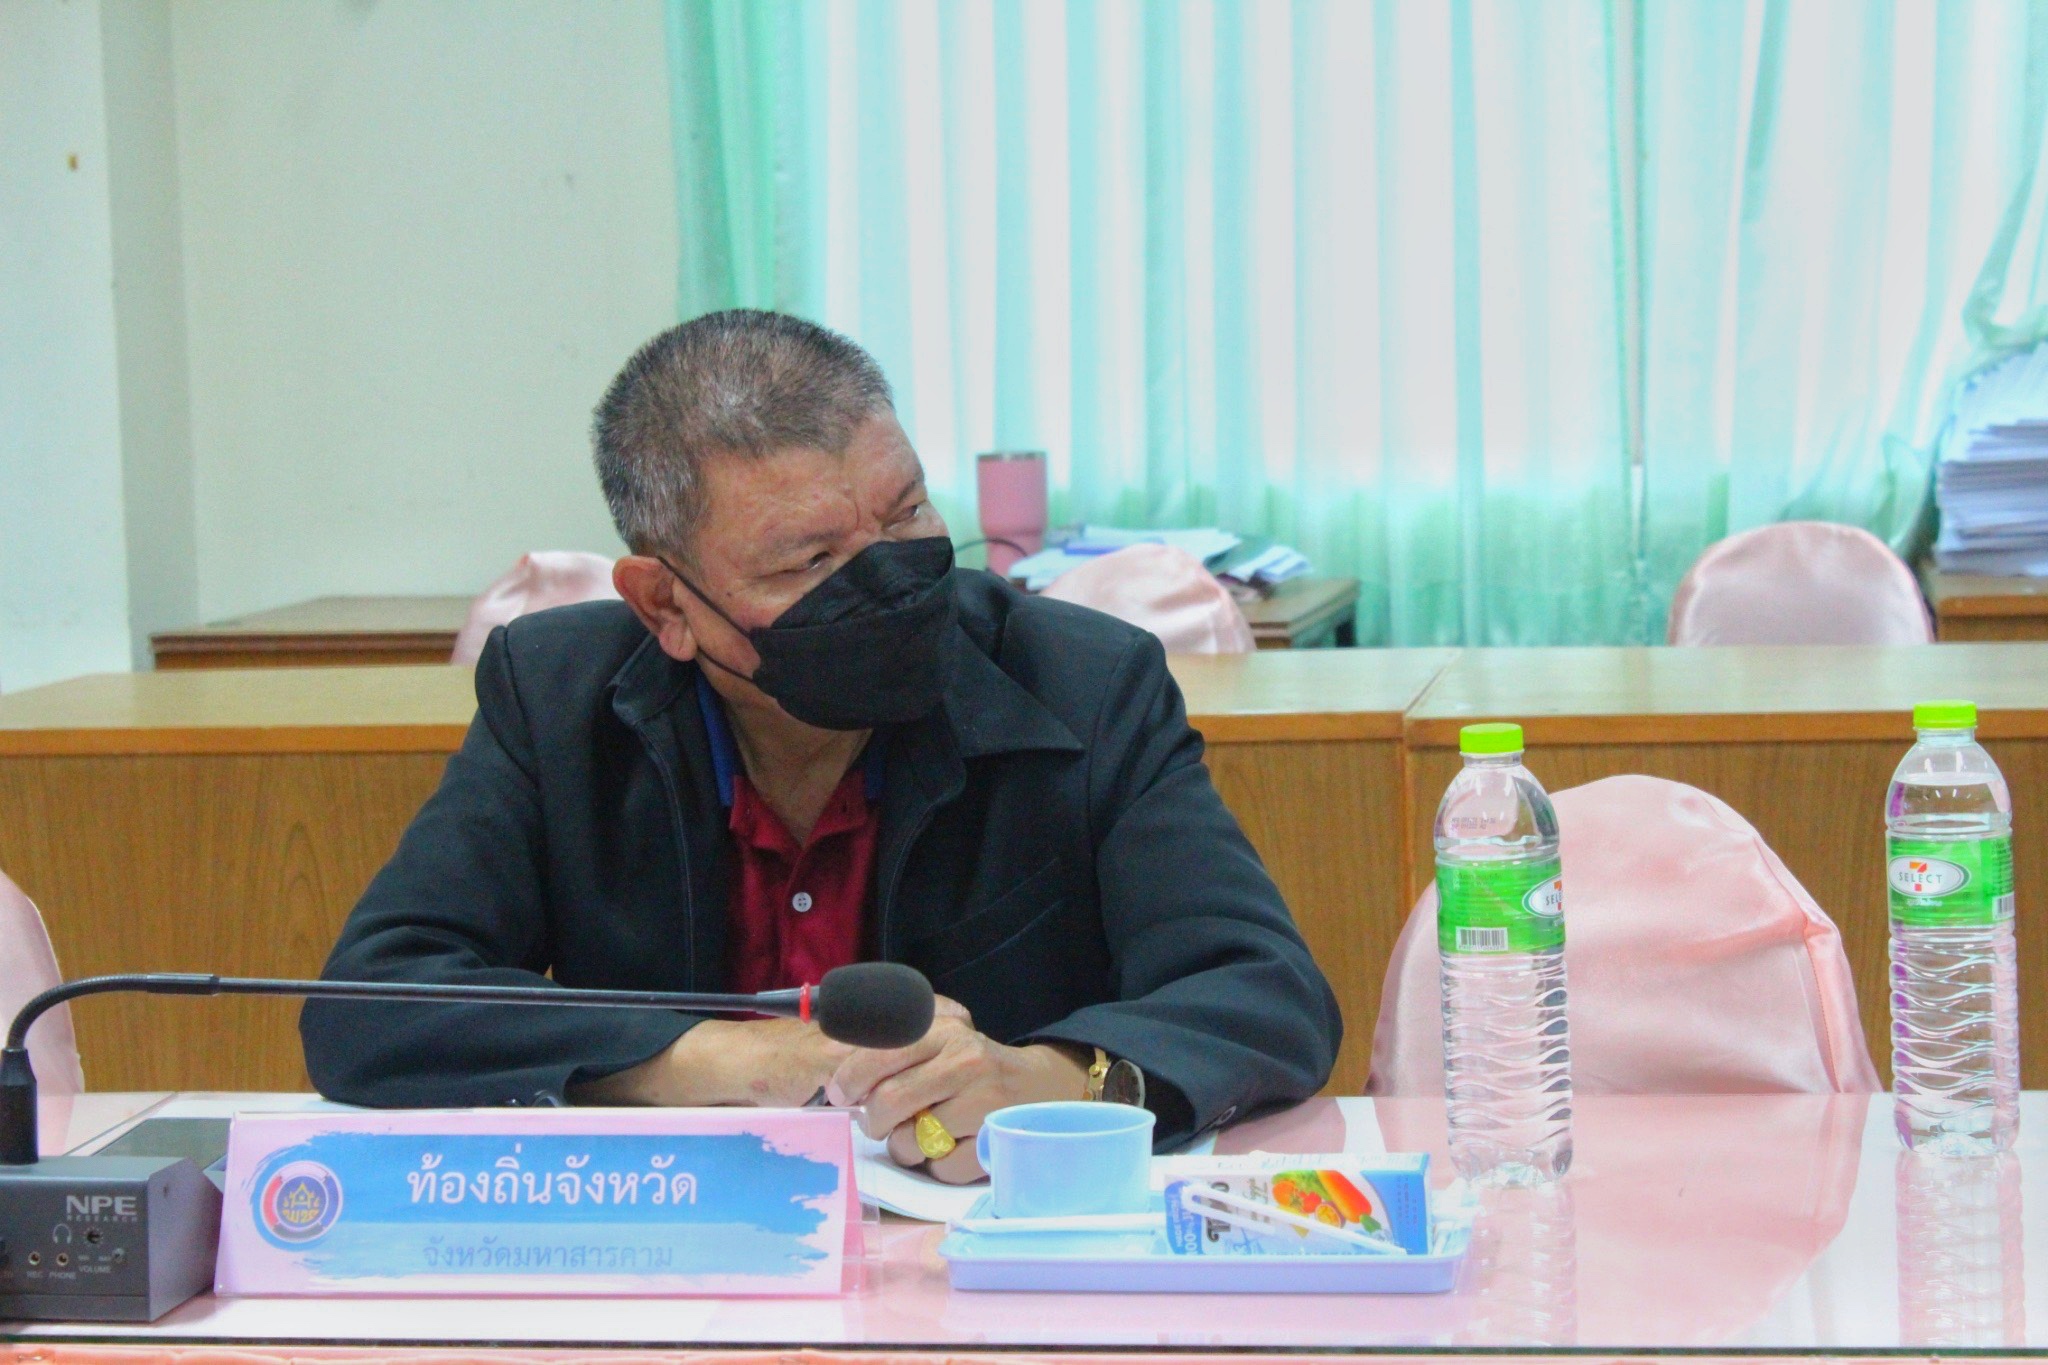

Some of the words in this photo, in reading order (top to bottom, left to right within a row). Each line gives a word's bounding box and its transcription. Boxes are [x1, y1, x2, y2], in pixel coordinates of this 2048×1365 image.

[1898, 872, 1943, 884] SELECT
[406, 1143, 698, 1206] ท้องถิ่นจังหวัด
[66, 1195, 137, 1215] NPE
[423, 1235, 673, 1268] จังหวัดมหาสารคาม
